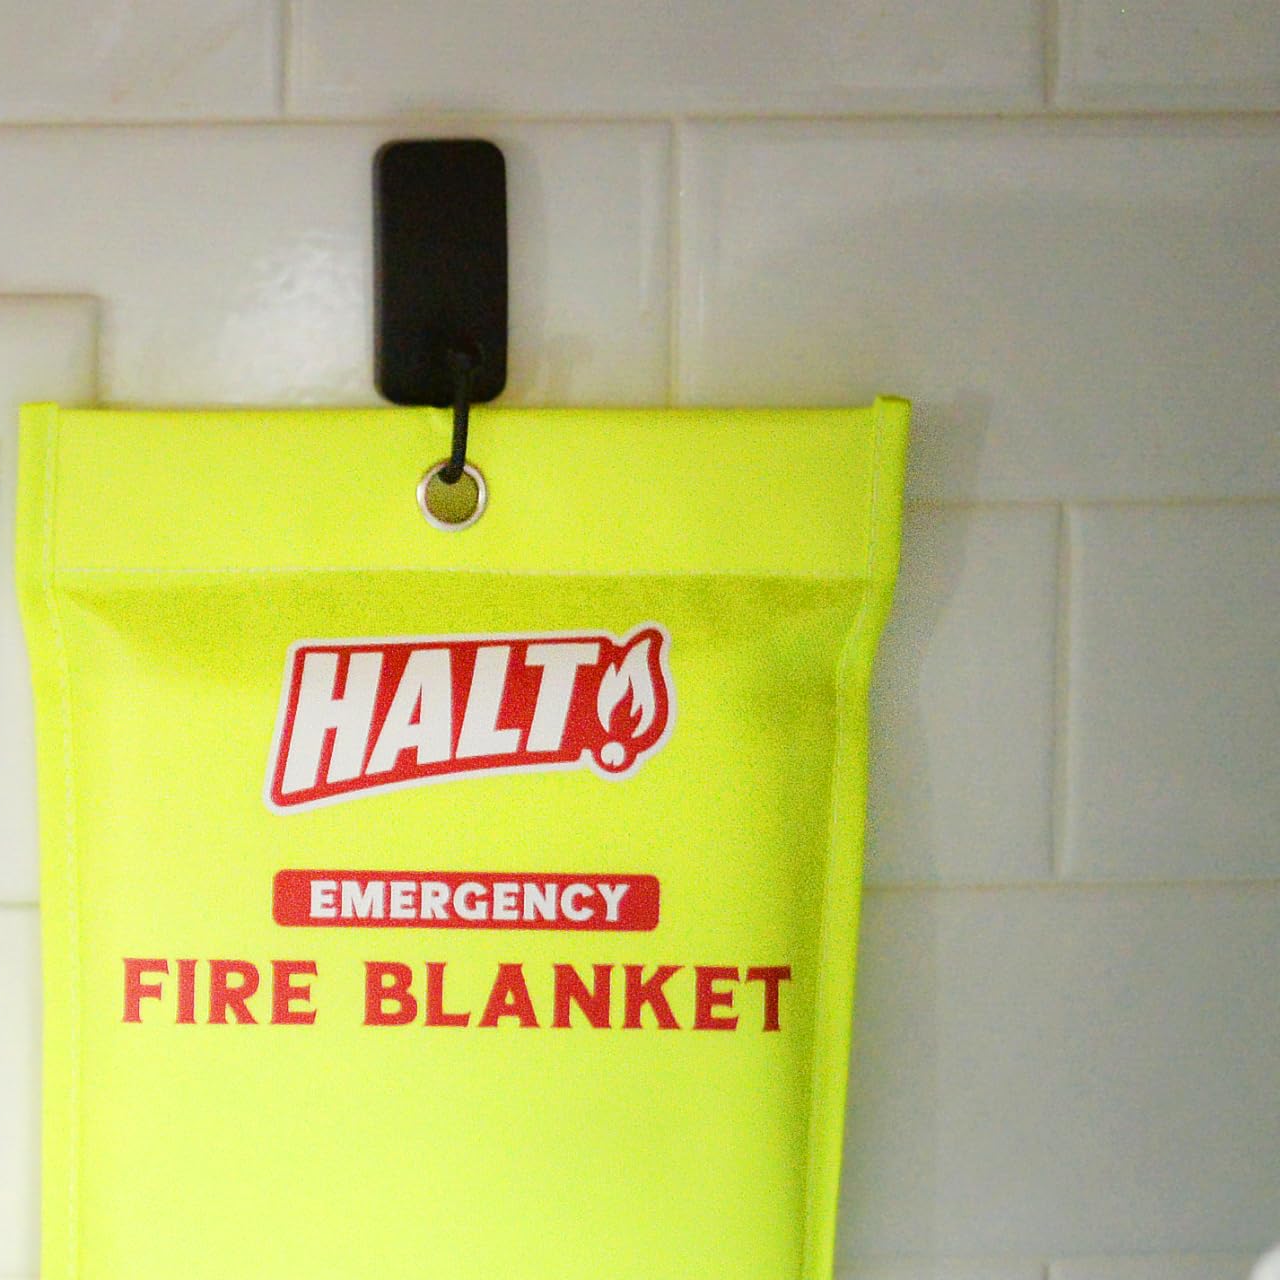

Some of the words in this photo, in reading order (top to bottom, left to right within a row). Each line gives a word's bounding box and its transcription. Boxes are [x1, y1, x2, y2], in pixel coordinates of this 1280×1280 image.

[308, 880, 630, 923] EMERGENCY
[121, 957, 319, 1026] FIRE
[362, 962, 792, 1033] BLANKET
